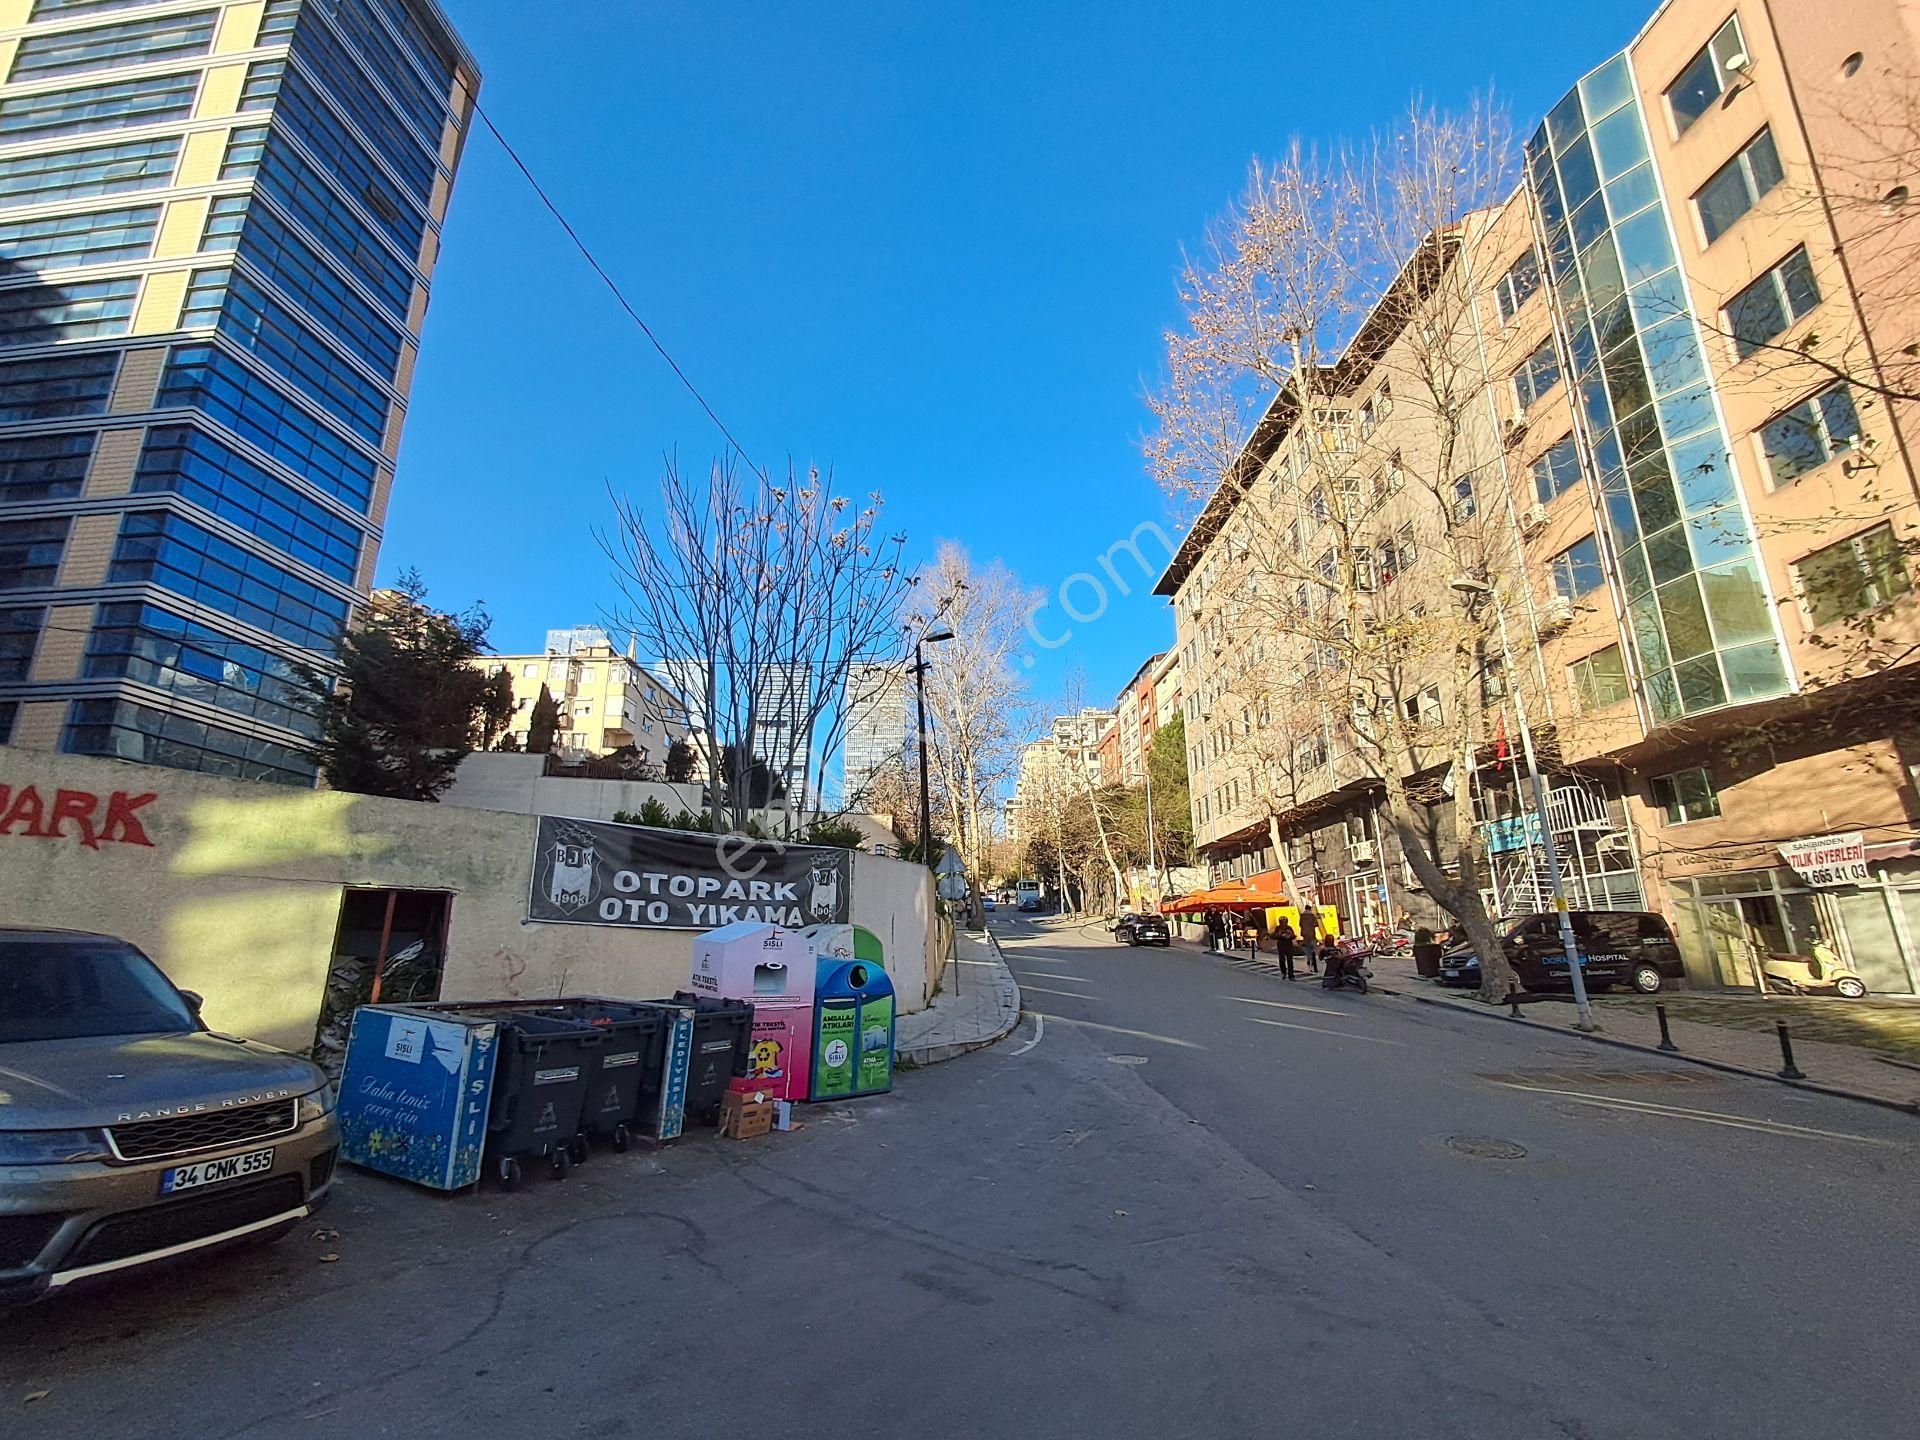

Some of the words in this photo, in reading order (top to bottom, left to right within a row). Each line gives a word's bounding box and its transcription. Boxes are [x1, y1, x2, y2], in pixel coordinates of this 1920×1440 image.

[613, 870, 801, 902] OTOPARK
[1812, 868, 1833, 884] 665
[1834, 865, 1849, 880] 41
[1850, 864, 1867, 879] 03
[554, 892, 587, 906] 1903
[599, 897, 669, 924] OTO
[689, 903, 805, 926] YIKAMA
[1588, 953, 1630, 963] HOSPITAL
[118, 1103, 206, 1122] RANGE
[222, 1089, 290, 1108] ROVER
[174, 1167, 199, 1188] 34
[204, 1157, 240, 1182] CNK
[242, 1150, 273, 1173] 555
